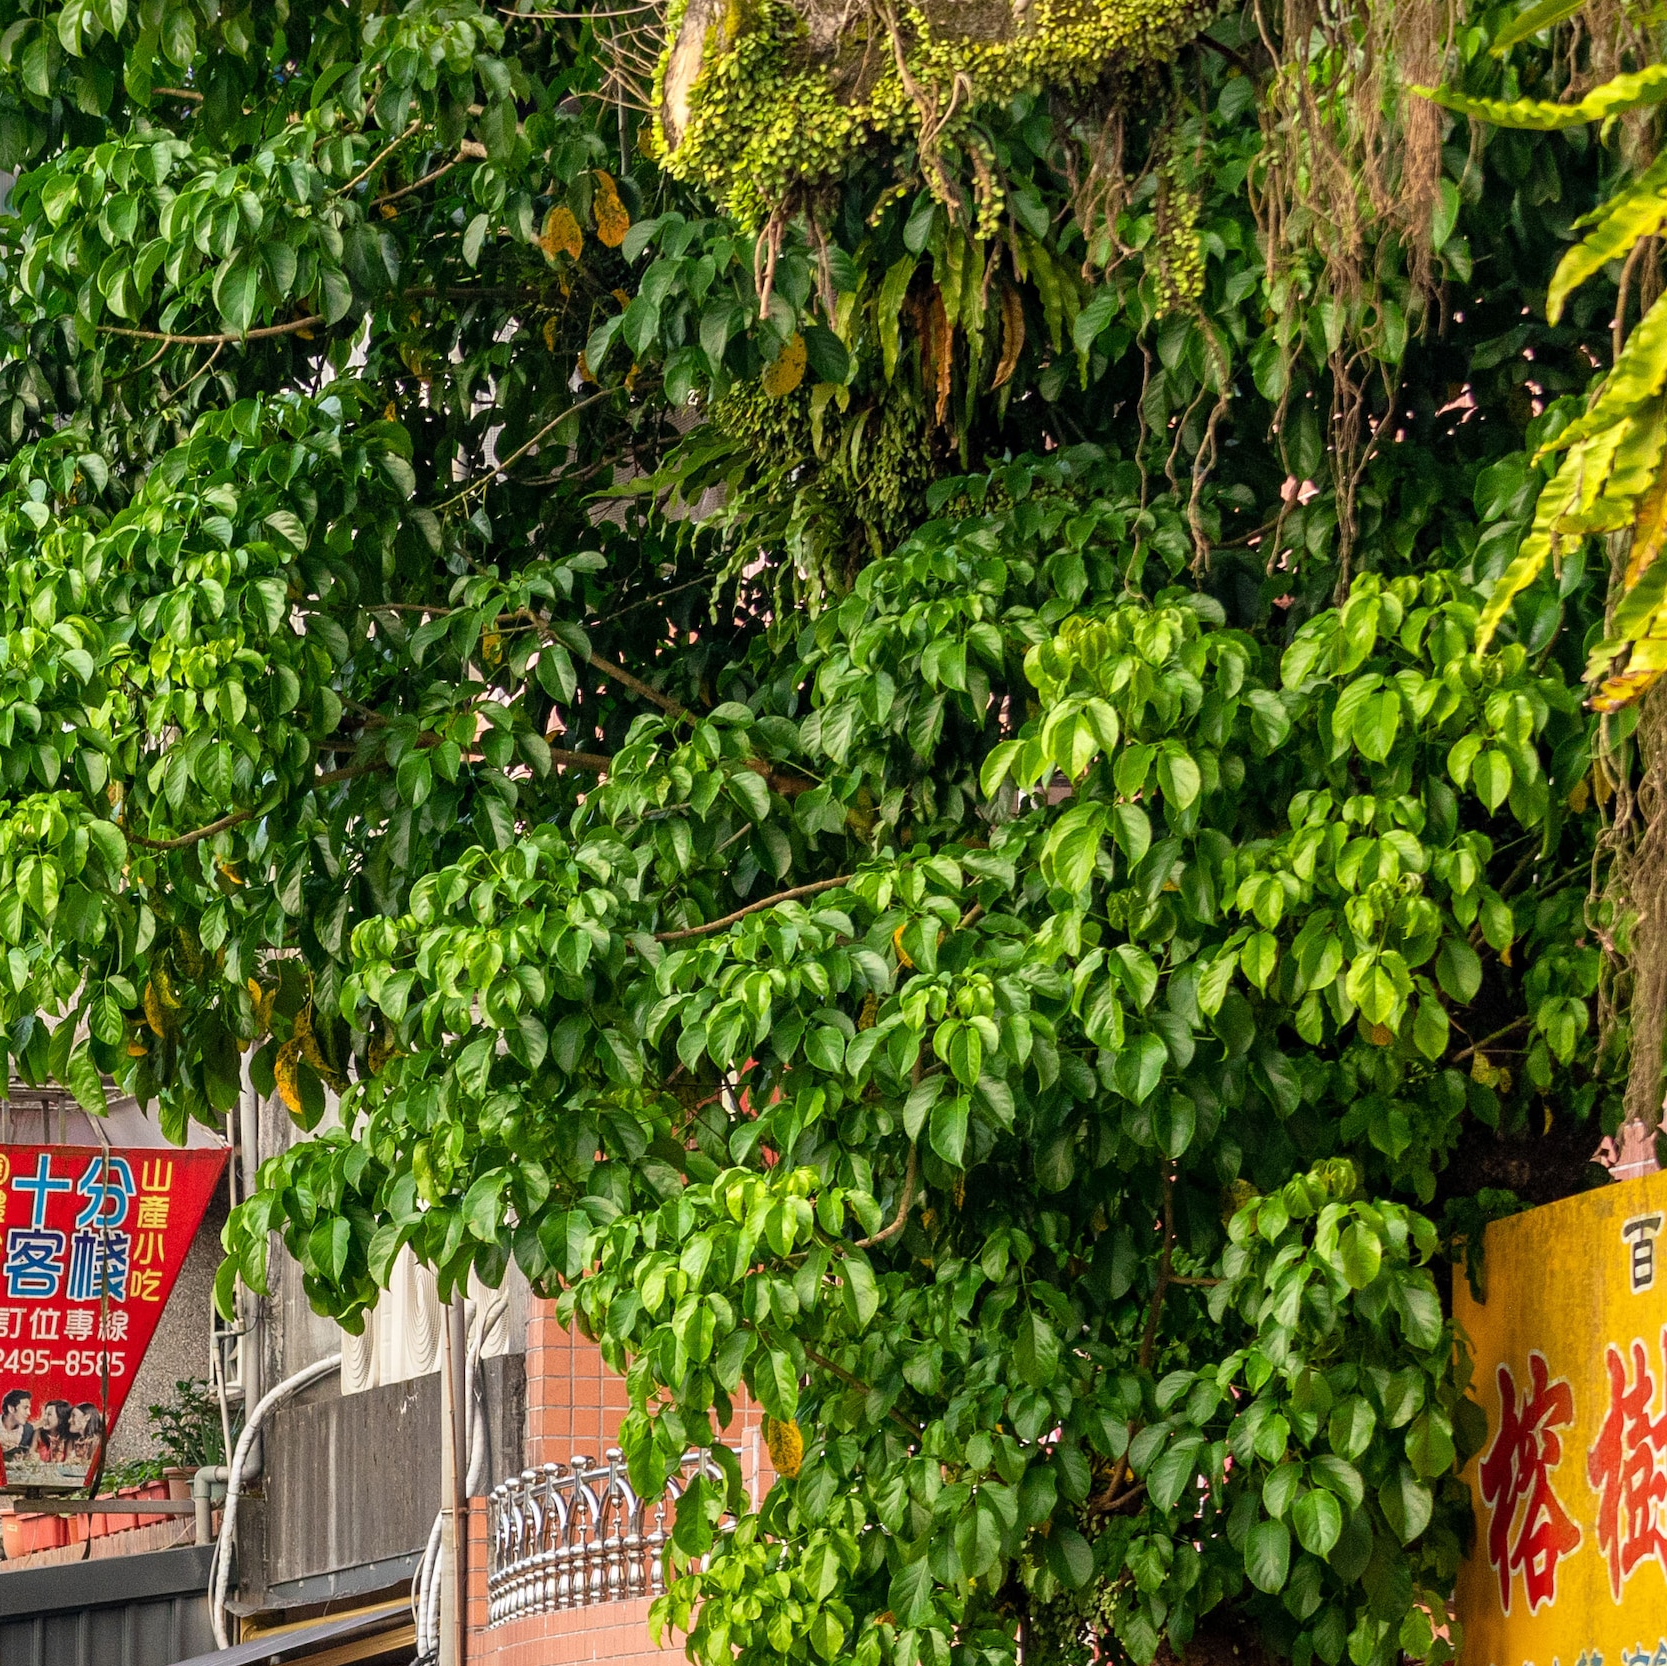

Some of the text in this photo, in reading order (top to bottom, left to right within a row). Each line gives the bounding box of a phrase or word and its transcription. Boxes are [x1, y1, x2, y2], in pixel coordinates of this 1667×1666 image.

[12, 1153, 135, 1229] 十分
[3, 1228, 131, 1302] 客棧
[129, 1159, 173, 1303] 山產小吃
